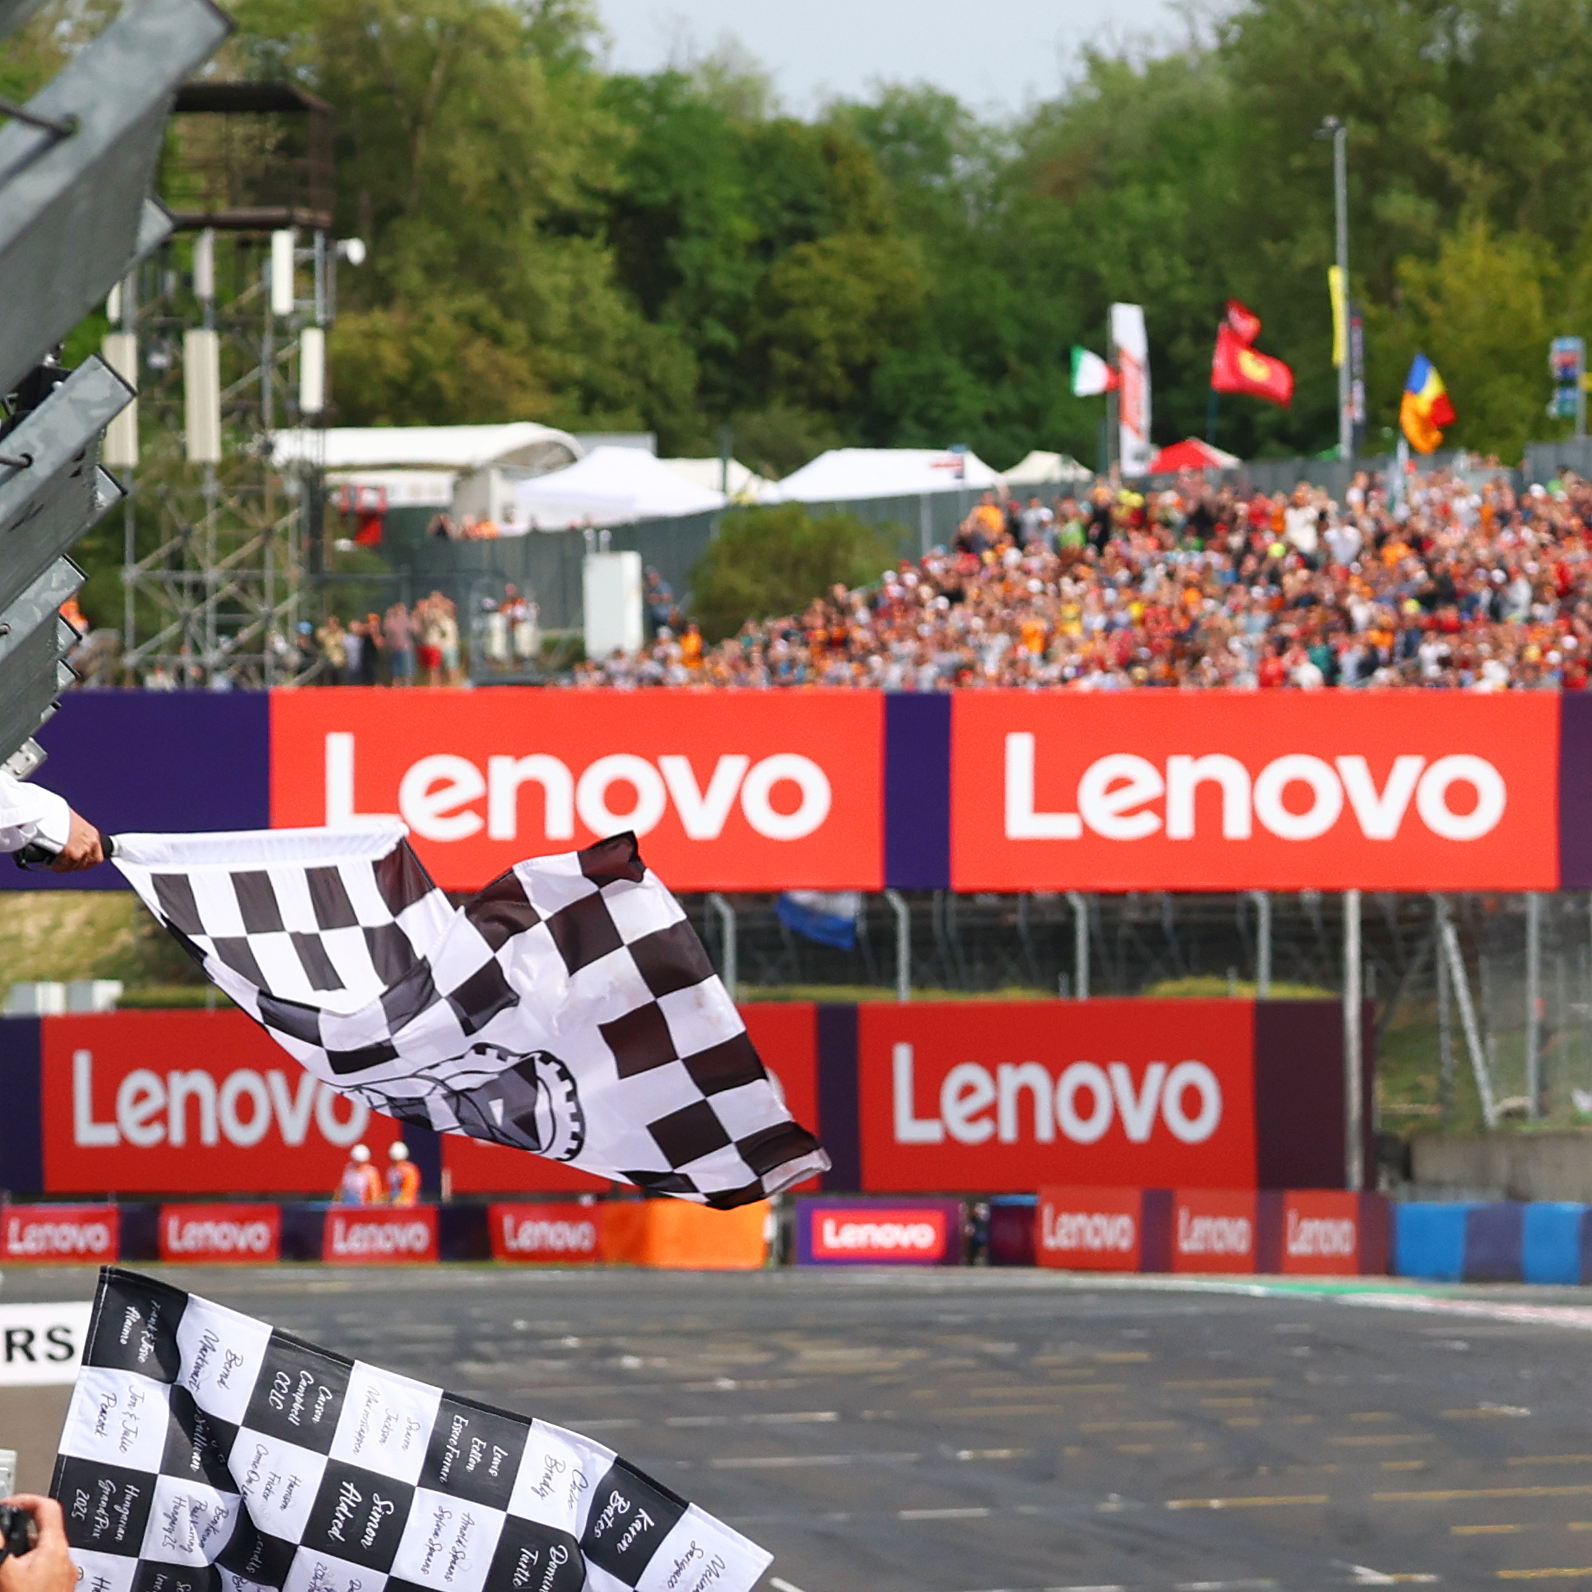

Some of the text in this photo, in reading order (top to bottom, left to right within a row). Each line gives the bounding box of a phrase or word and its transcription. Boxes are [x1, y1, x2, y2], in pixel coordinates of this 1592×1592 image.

[325, 733, 831, 841] Lenovo
[1005, 732, 1507, 841] Lenovo
[73, 1049, 371, 1147] Lenovo
[893, 1042, 1223, 1145] Lenovo
[7, 1218, 110, 1254] Lenovo
[167, 1216, 271, 1253] Lenovo
[332, 1218, 430, 1255] Lenovo
[503, 1214, 596, 1252] Lenovo
[822, 1217, 935, 1250] Lenovo
[1042, 1204, 1134, 1253] Lenovo
[1178, 1206, 1251, 1256] Lenovo
[1287, 1206, 1356, 1258] Lenovo
[217, 1349, 243, 1389] Bernd
[95, 1393, 117, 1437] Peacock
[288, 1370, 313, 1426] Campbell
[311, 1386, 332, 1423] Carson
[379, 1408, 399, 1446] Jackson
[488, 1445, 508, 1477] Lewis
[531, 1454, 565, 1500] Brady
[71, 1489, 90, 1520] 2025
[113, 1485, 140, 1542] Hungarian
[328, 1481, 362, 1542] Aldred
[360, 1493, 394, 1549] Simon
[593, 1491, 631, 1539] Bates
[616, 1508, 655, 1554] Karen
[512, 1547, 538, 1587] Turtle
